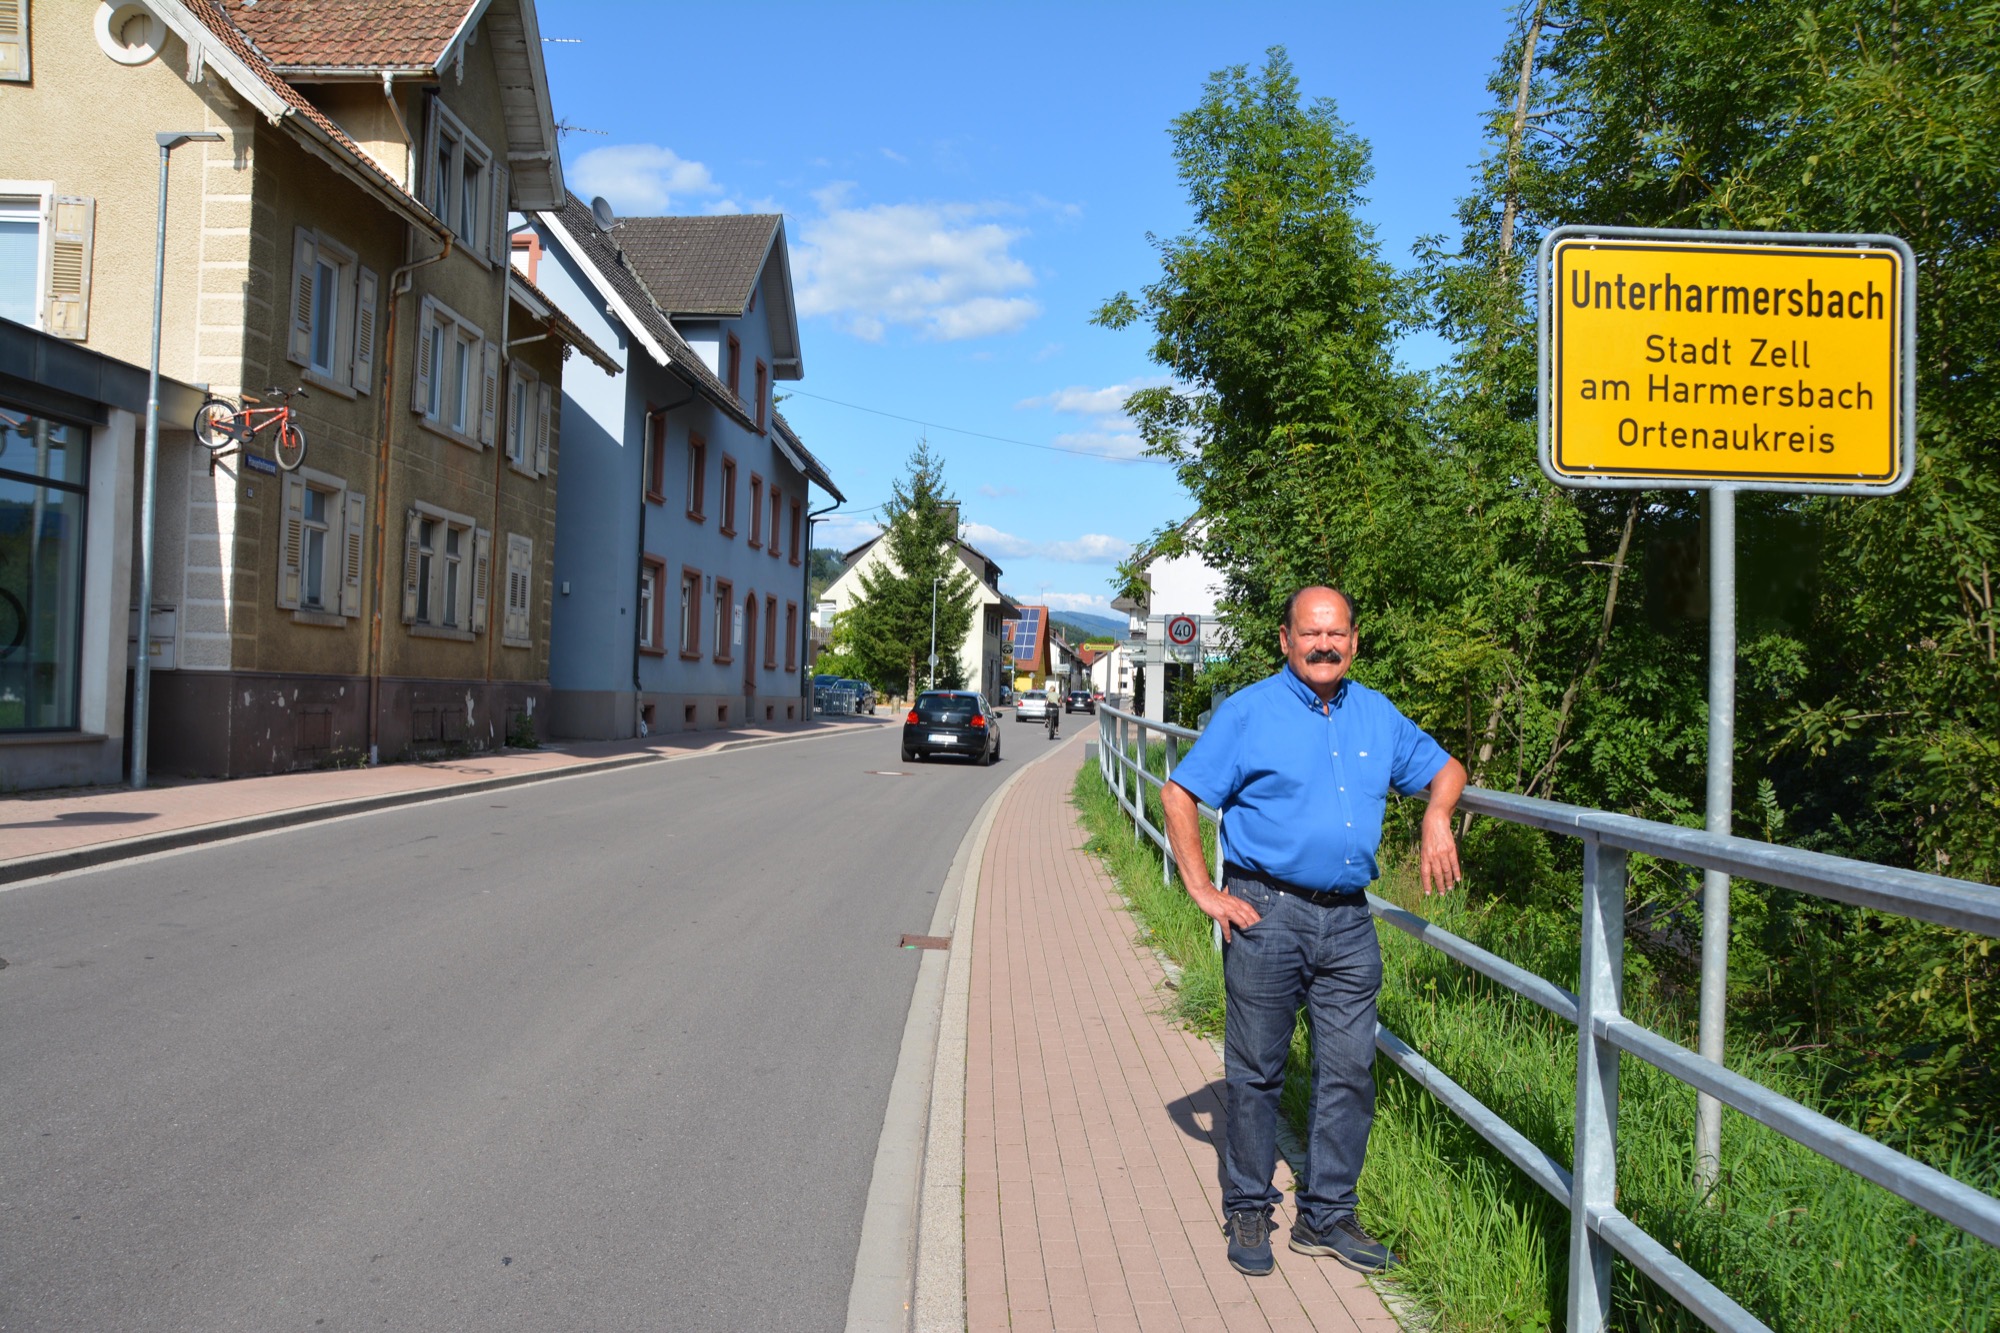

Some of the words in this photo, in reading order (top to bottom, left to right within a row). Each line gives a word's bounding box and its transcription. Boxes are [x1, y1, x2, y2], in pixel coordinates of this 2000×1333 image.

[1572, 269, 1884, 320] Unterharmersbach
[1646, 334, 1731, 366] Stadt
[1750, 338, 1810, 369] Zell
[1580, 378, 1630, 401] am
[1648, 373, 1874, 410] Harmersbach
[1618, 417, 1836, 454] Ortenaukreis
[1174, 623, 1191, 638] 40
